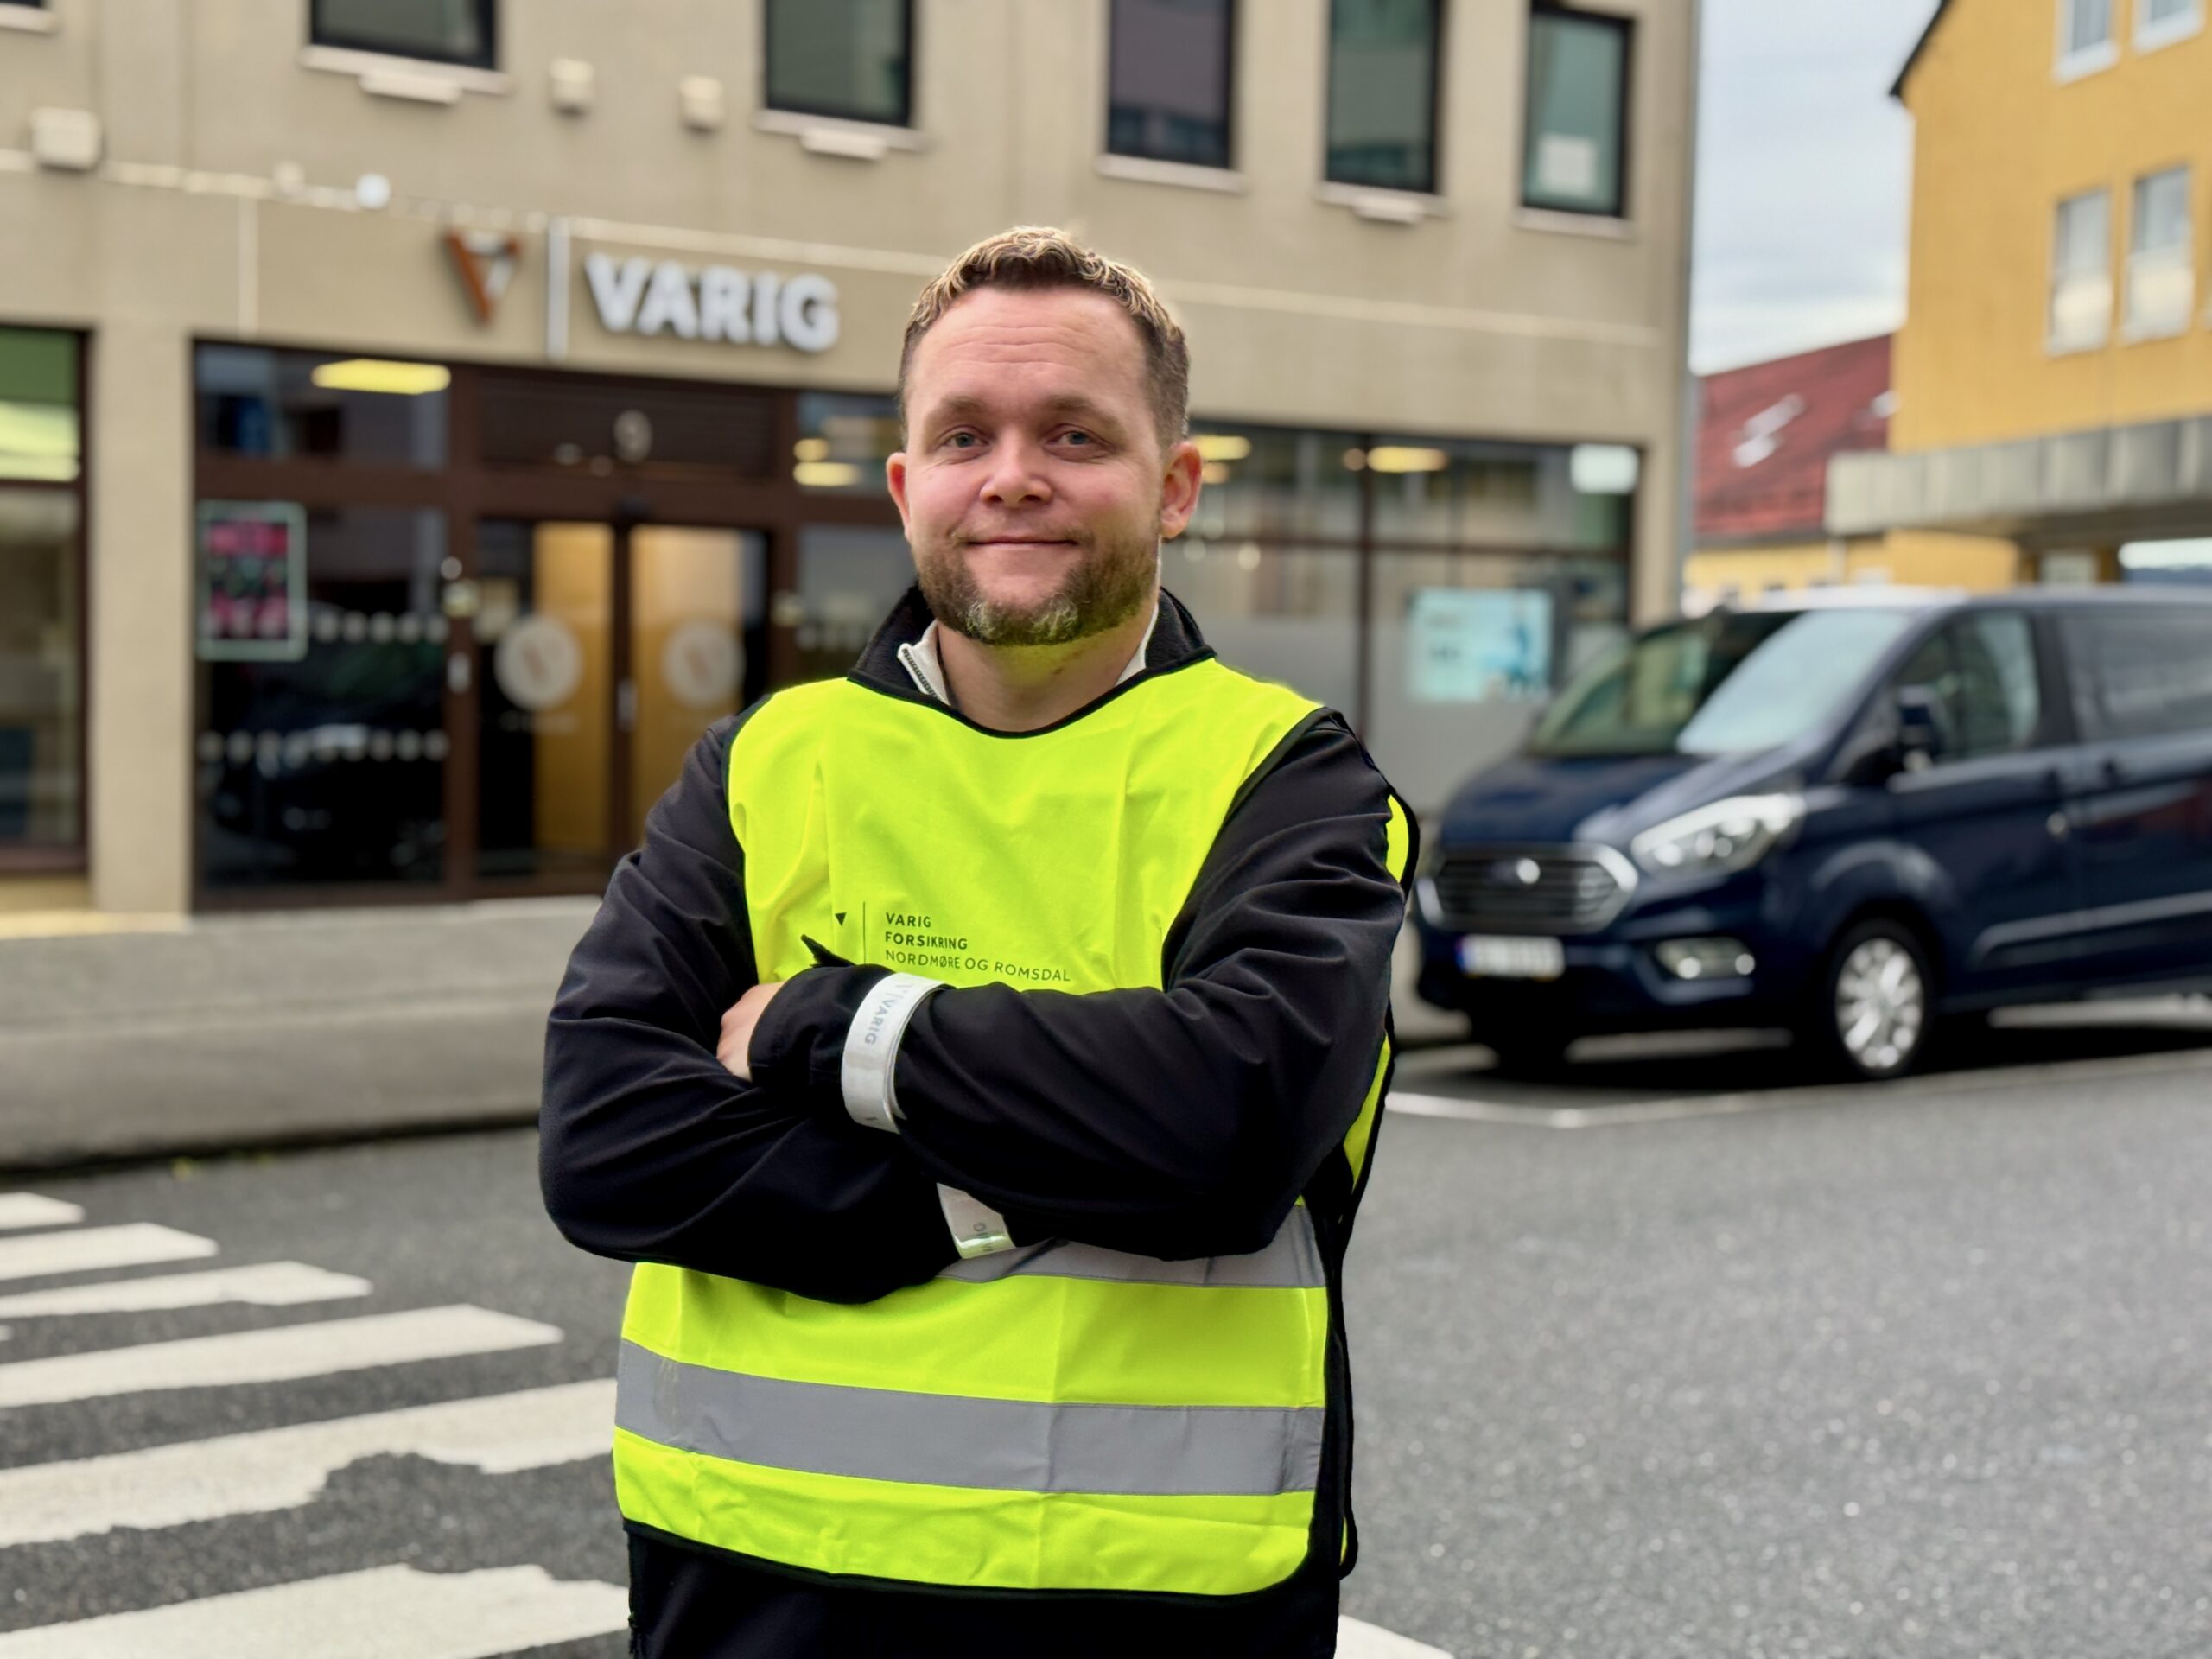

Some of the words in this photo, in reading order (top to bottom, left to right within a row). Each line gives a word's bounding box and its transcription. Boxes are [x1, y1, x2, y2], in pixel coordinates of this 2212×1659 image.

[584, 252, 840, 352] VARIG
[885, 912, 931, 929] VARIG
[885, 931, 968, 950] FORSIKRING
[885, 949, 961, 969] NORDMØRE
[964, 957, 988, 971] OG
[994, 961, 1071, 982] ROMSDAL
[864, 999, 896, 1046] VARIG
